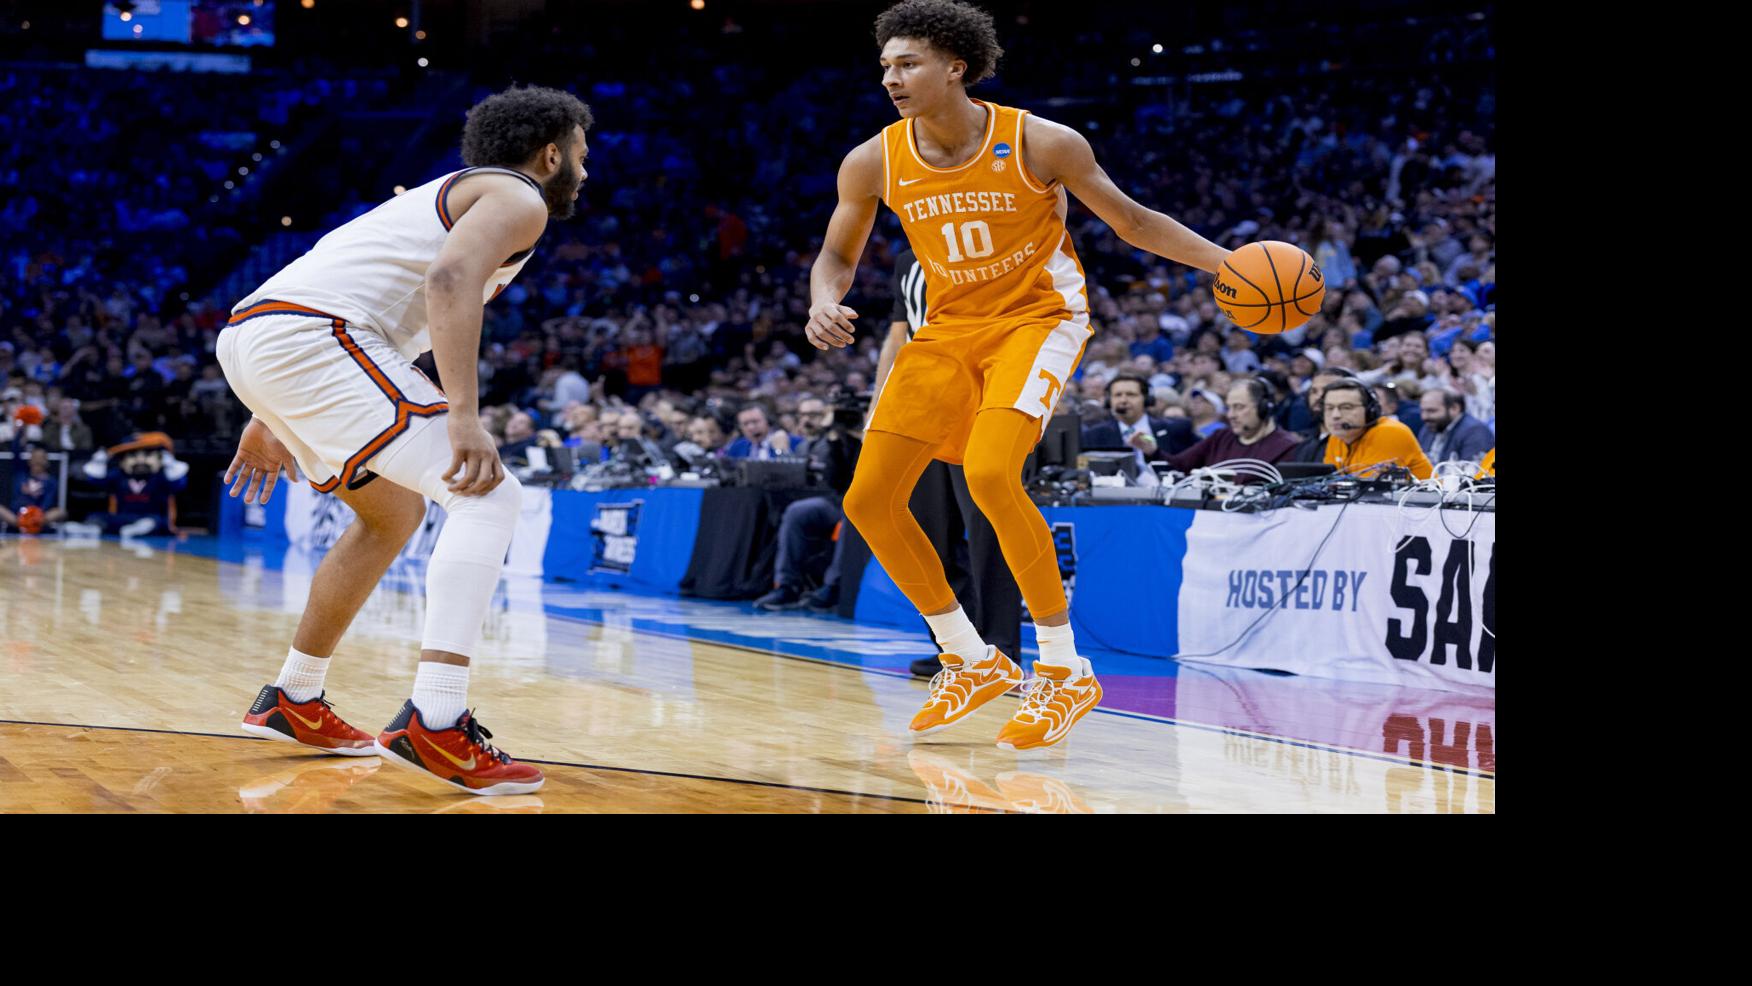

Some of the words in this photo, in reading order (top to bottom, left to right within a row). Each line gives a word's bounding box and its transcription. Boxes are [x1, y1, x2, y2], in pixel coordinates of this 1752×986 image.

[904, 192, 1017, 223] TENNESSEE
[941, 221, 994, 263] 10
[926, 242, 1036, 285] OUNTEERS
[1039, 368, 1061, 410] T
[1226, 570, 1328, 610] HOSTED
[1332, 570, 1367, 612] BY
